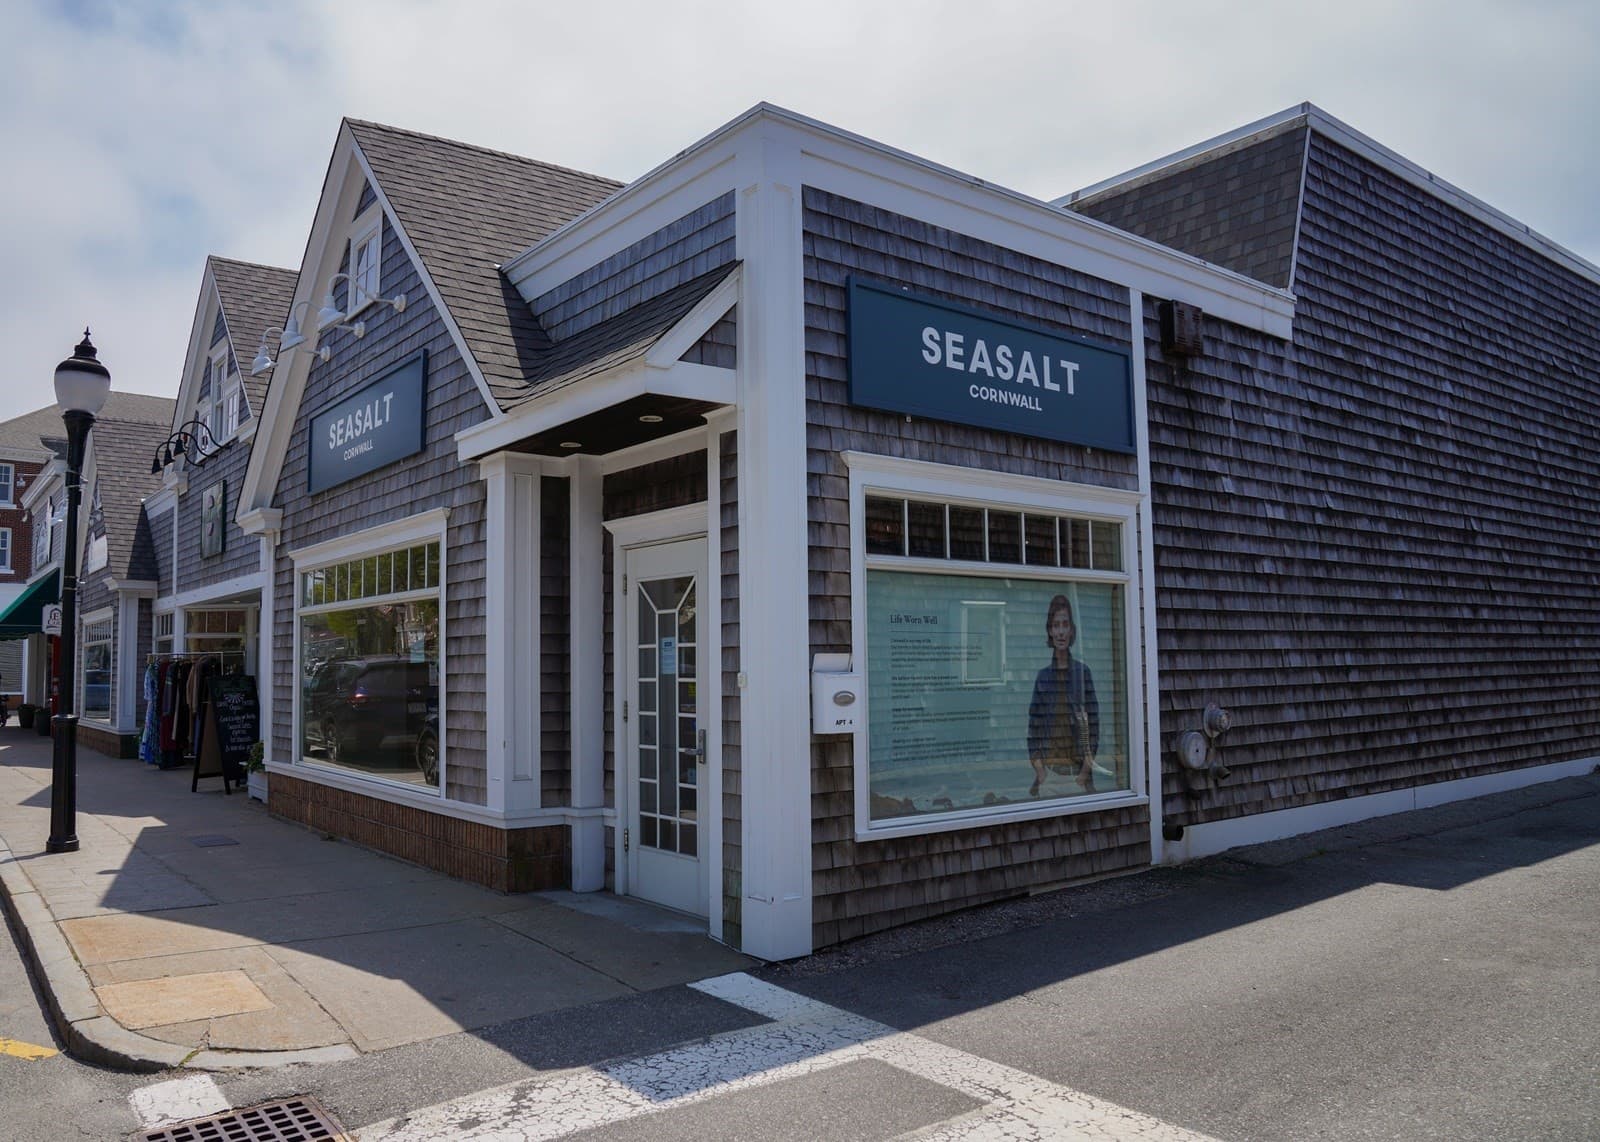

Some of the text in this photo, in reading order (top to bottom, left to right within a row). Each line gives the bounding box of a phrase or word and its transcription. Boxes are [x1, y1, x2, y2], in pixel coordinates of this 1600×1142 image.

[922, 326, 1079, 395] SEASALT
[969, 384, 1042, 411] CORNWALL
[329, 392, 393, 449] SEASALT
[344, 440, 373, 460] CORNWALL
[890, 614, 937, 624] Life Worn Well
